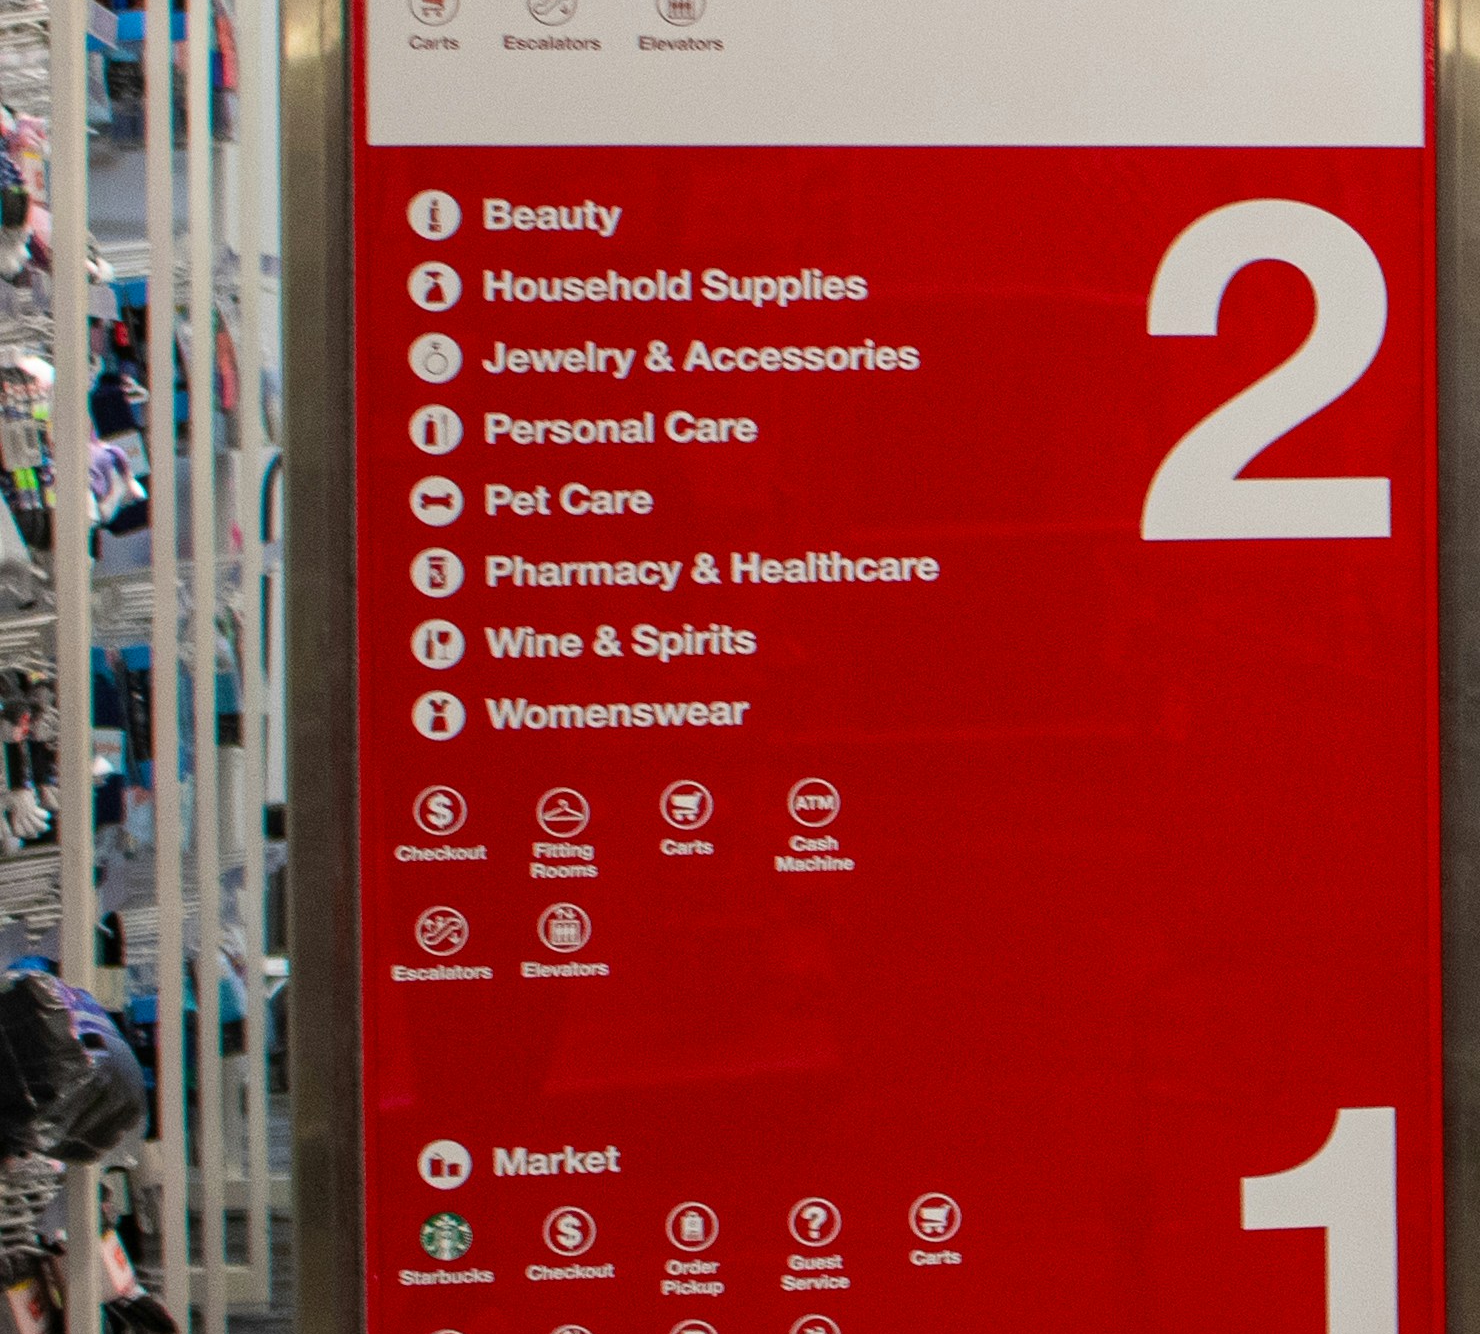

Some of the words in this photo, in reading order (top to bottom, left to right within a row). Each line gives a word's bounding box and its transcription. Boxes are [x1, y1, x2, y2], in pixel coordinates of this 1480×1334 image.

[408, 35, 461, 51] Carts
[503, 34, 602, 51] Escalators
[638, 35, 725, 52] Elevators
[482, 198, 621, 237] Beauty
[483, 269, 691, 302] Household
[700, 268, 868, 307] Supplies
[482, 342, 634, 379] Jewelry
[644, 343, 674, 372] &
[684, 339, 920, 372] Accessories
[1140, 197, 1392, 541] 2
[484, 412, 654, 445] Personal
[664, 412, 758, 444] Care
[484, 484, 550, 515] Pet
[559, 483, 653, 514] Care
[485, 556, 682, 591] Pharmacy
[691, 554, 720, 584] &
[730, 550, 940, 583] Healthcare
[485, 627, 583, 658] Wine
[593, 627, 621, 657] &
[632, 624, 757, 662] Spirits
[485, 699, 750, 729] Womenswear
[795, 795, 834, 810] ATM
[532, 842, 595, 861] Fitting
[660, 839, 714, 856] Carts
[789, 835, 840, 852] Cash
[394, 845, 488, 862] Checkout
[529, 863, 598, 879] Rooms
[774, 856, 855, 872] Machine
[390, 965, 493, 982] Escalators
[520, 961, 610, 978] Elevators
[492, 1145, 621, 1176] Market
[787, 1255, 844, 1271] Guest
[908, 1250, 962, 1266] Carts
[525, 1264, 615, 1282] Checkout
[665, 1260, 720, 1276] Order
[398, 1269, 495, 1286] Starbucks
[780, 1275, 850, 1292] Service
[661, 1280, 725, 1297] Pickup
